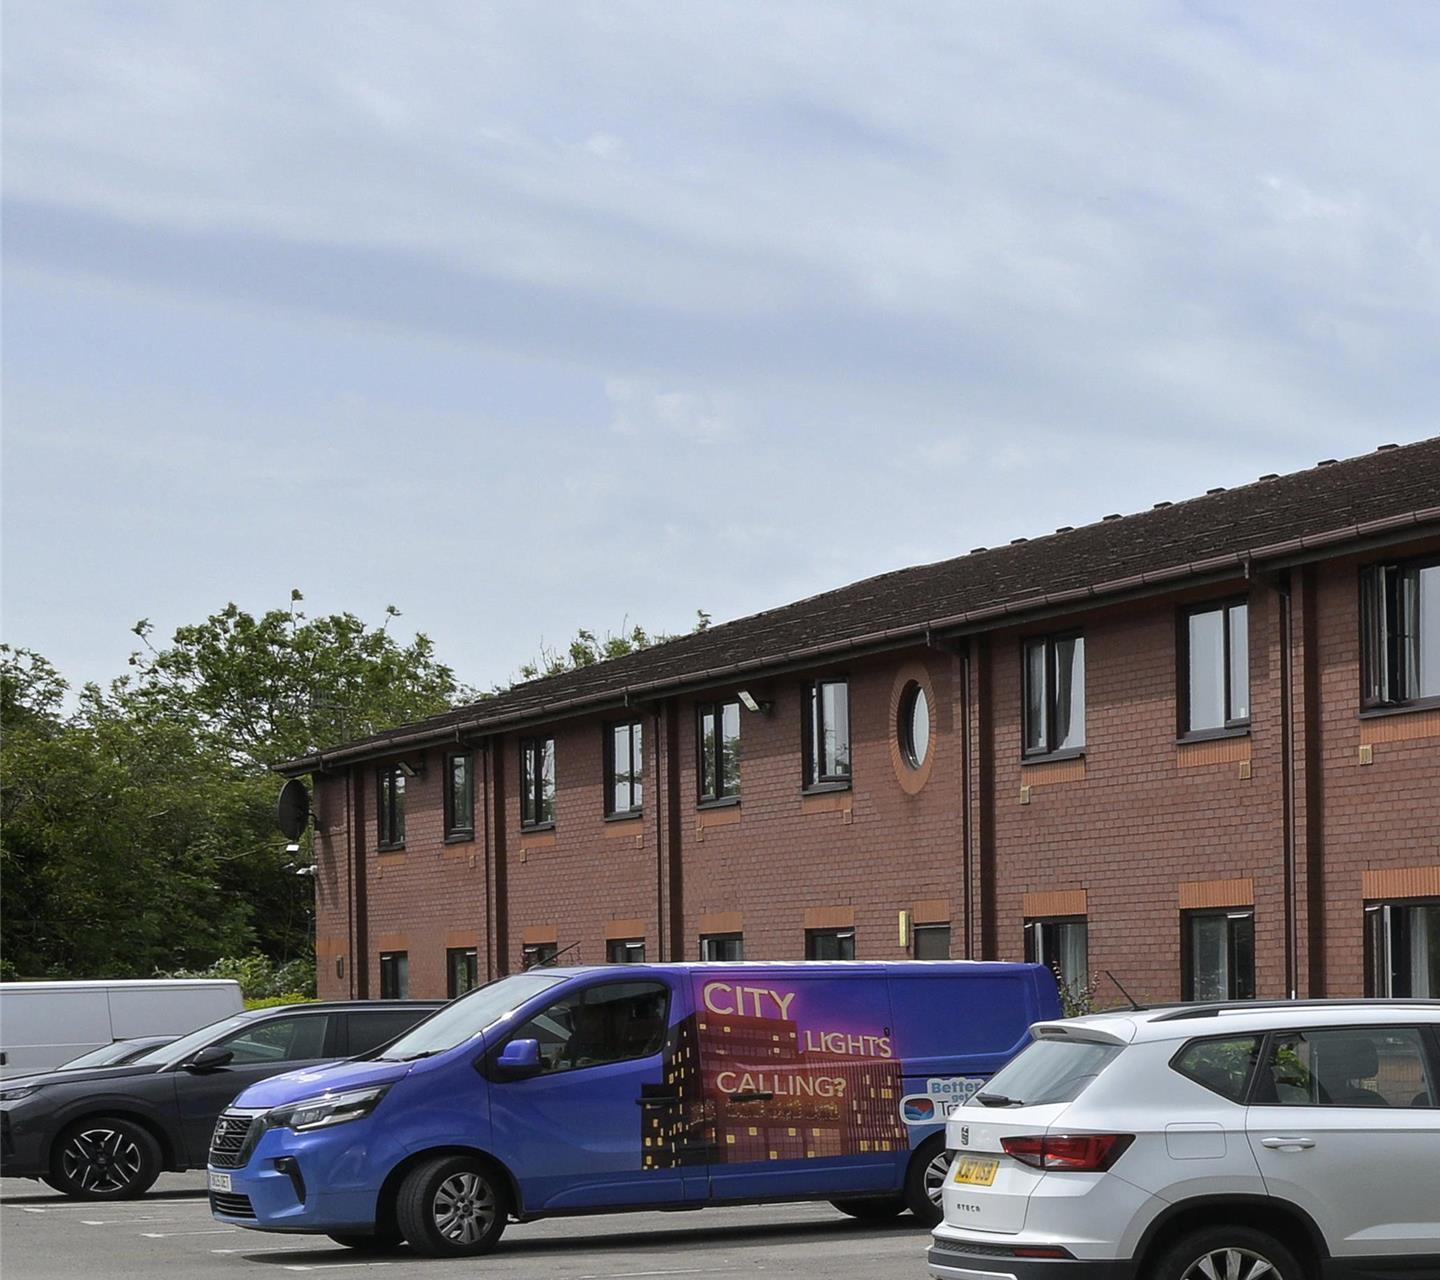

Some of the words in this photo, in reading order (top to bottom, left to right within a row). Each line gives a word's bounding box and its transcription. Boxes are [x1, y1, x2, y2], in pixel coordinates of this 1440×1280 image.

[703, 982, 795, 1020] CITY
[805, 1030, 892, 1058] LIGHTS
[716, 1071, 847, 1098] CALLING?
[931, 1081, 980, 1093] Better
